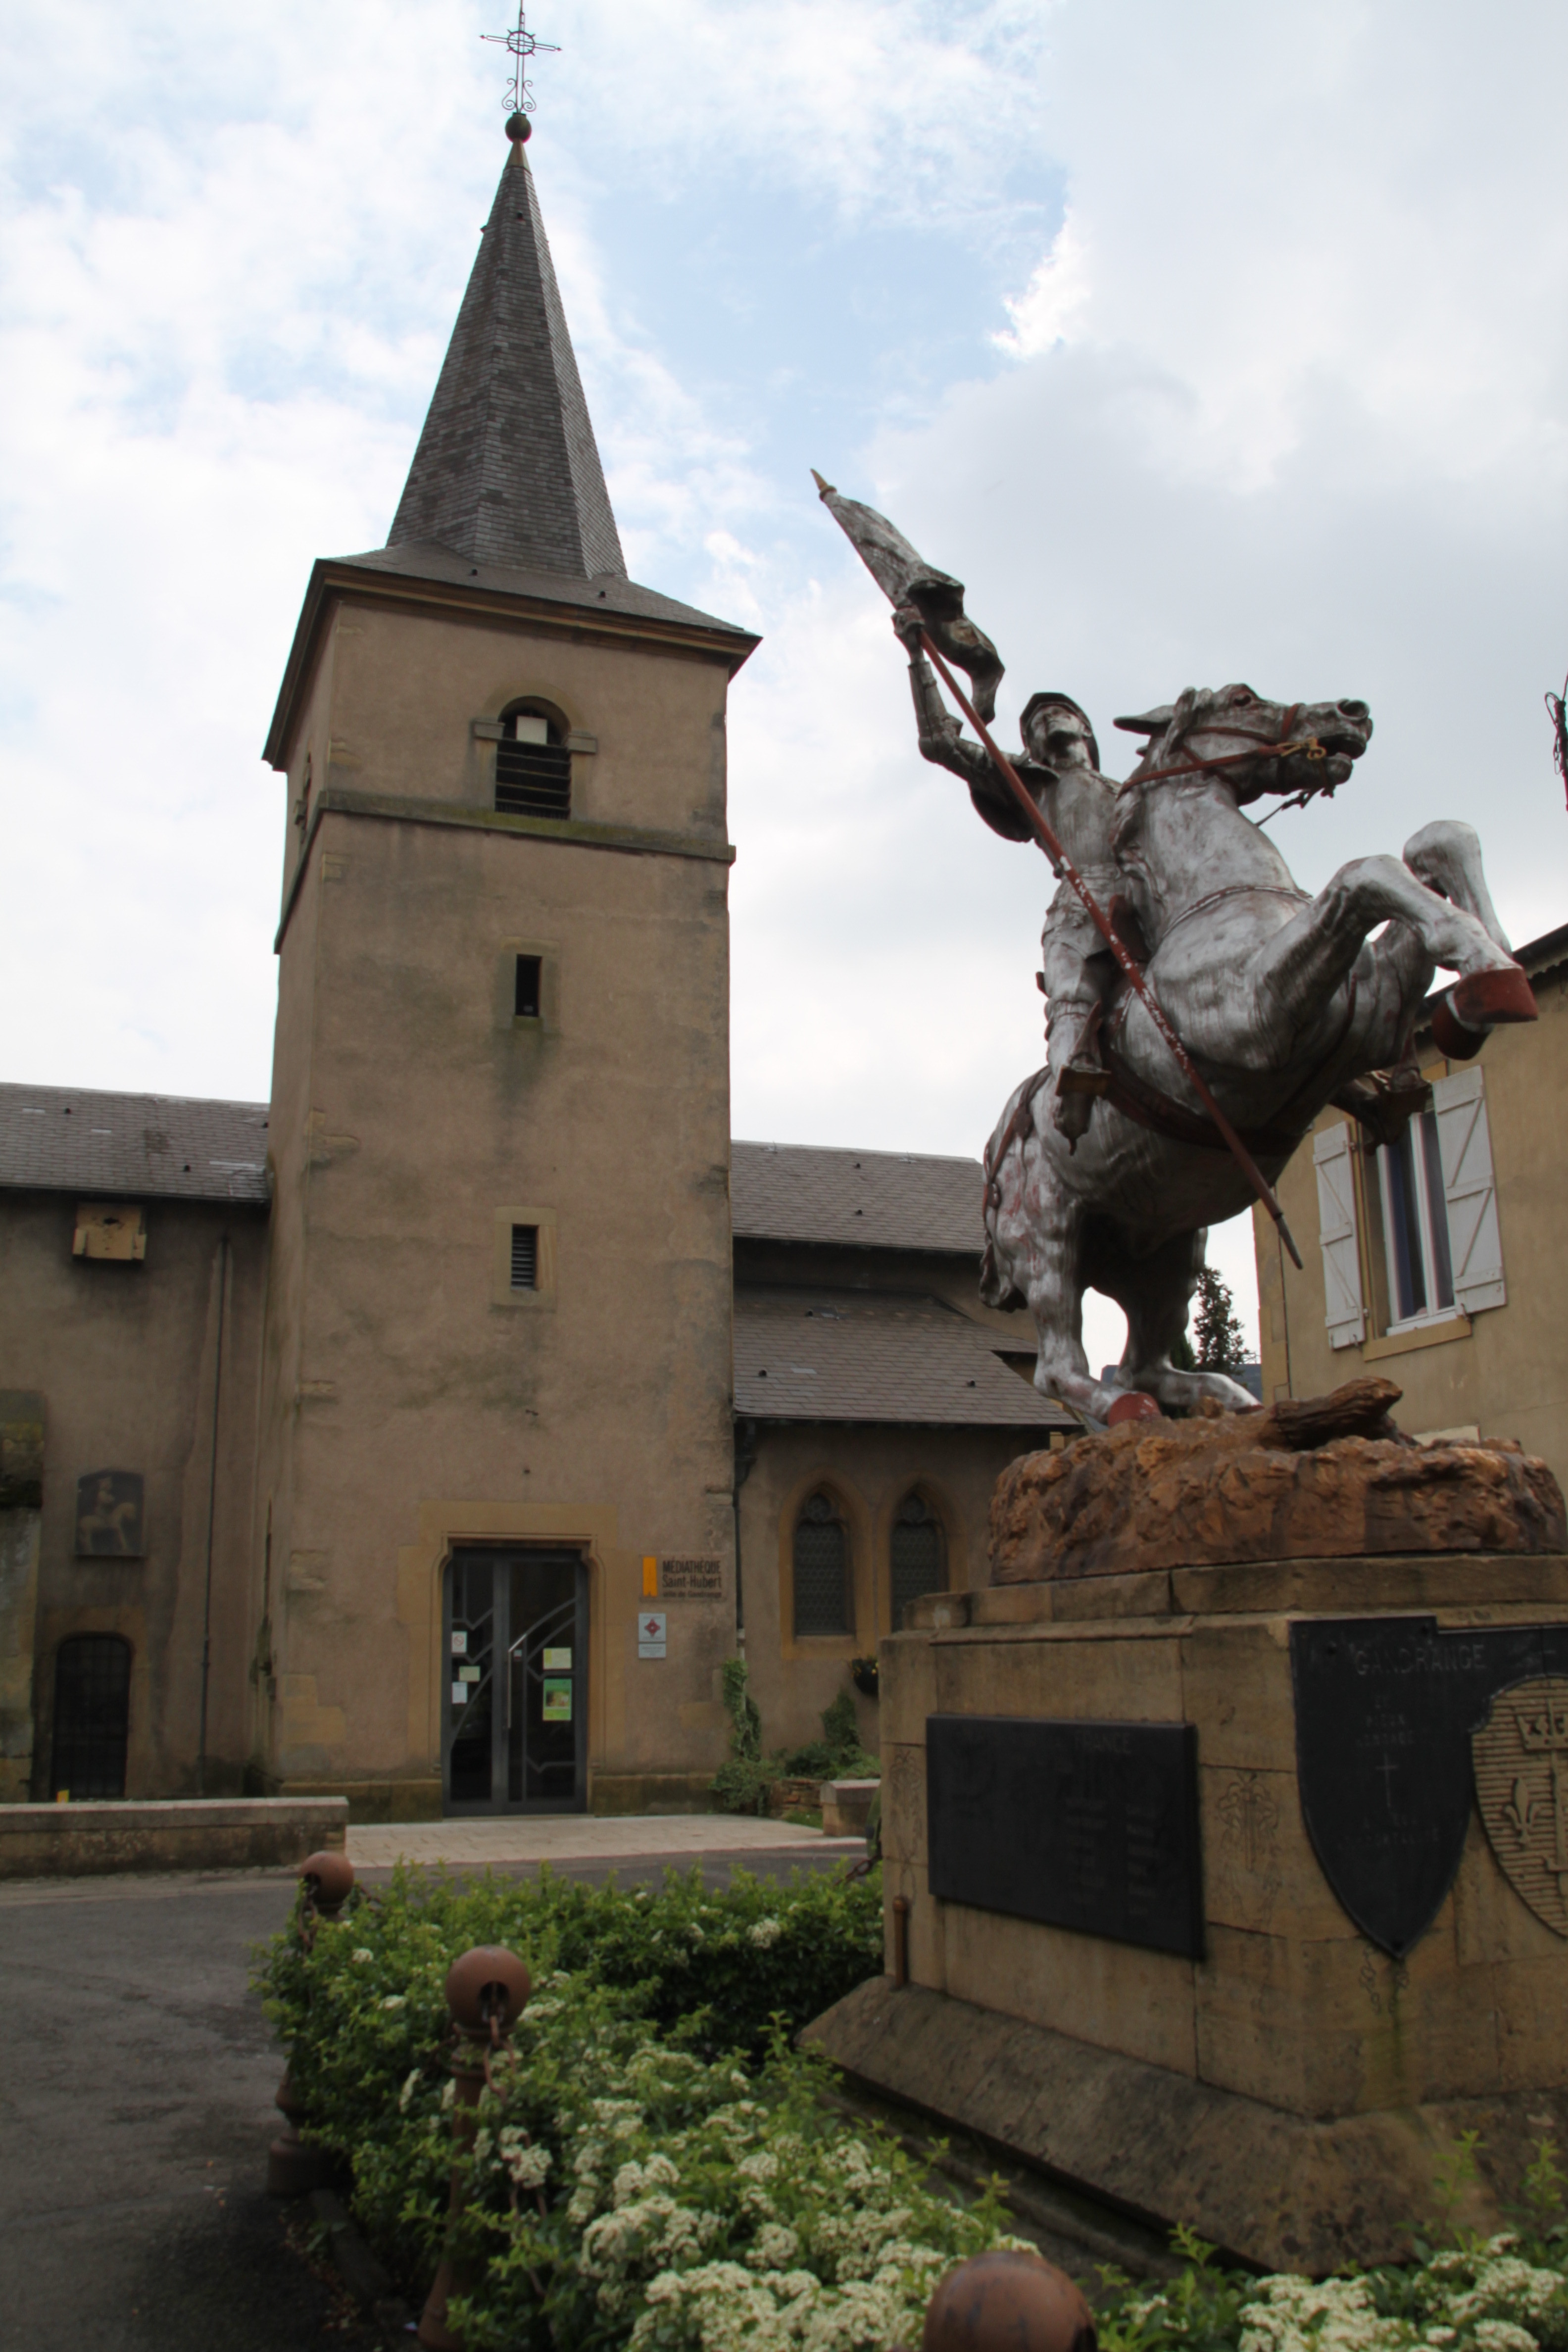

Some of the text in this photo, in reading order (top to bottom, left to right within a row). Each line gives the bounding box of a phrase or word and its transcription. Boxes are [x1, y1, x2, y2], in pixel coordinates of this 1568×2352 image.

[662, 1557, 721, 1573] MÉDIATHÈQUE
[662, 1574, 721, 1588] Saint-Hubert
[1355, 1644, 1487, 1675] GANDRANGE
